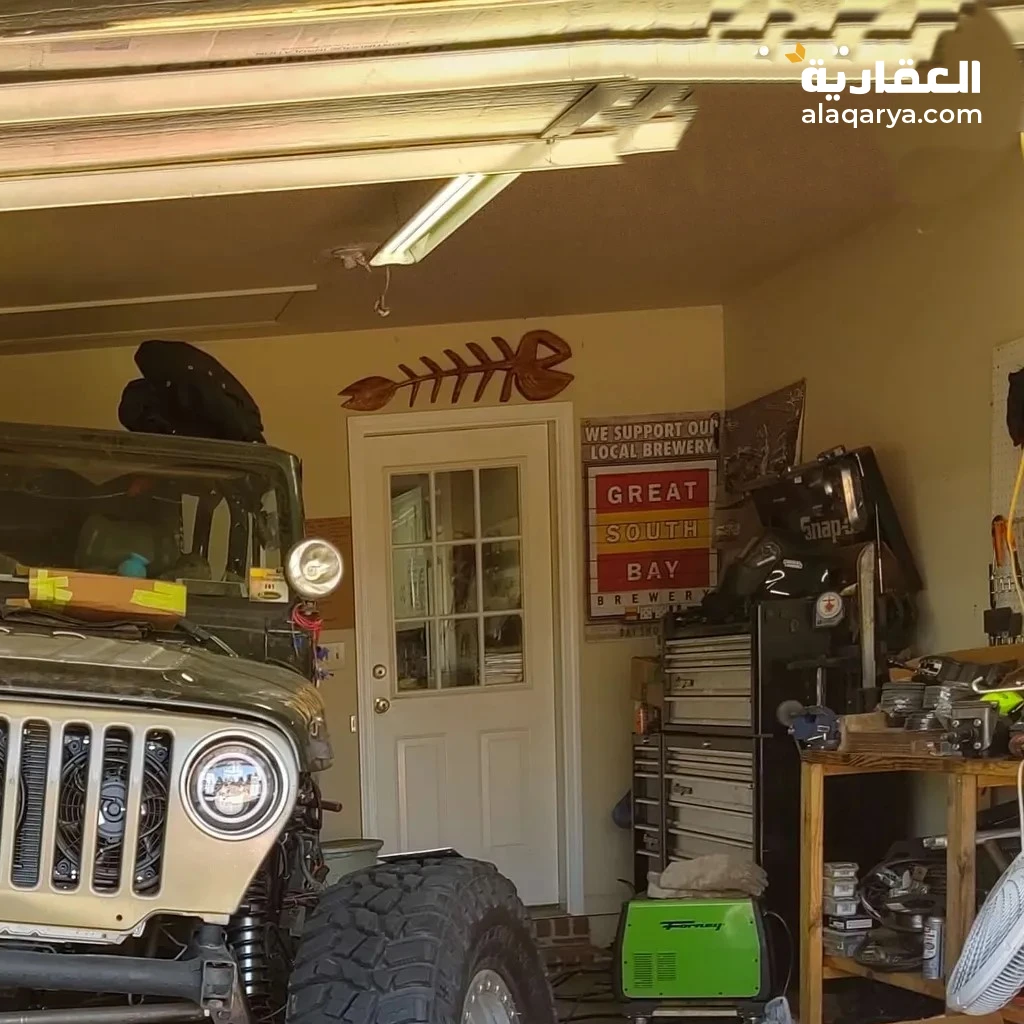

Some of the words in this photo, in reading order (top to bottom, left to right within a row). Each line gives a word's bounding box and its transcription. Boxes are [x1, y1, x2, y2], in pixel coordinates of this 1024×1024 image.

[585, 426, 608, 442] WE
[614, 421, 682, 441] SUPPORT
[590, 444, 637, 460] LOCAL
[642, 438, 715, 457] BREWERY
[607, 481, 697, 504] GREAT
[606, 521, 697, 543] SOUTH
[627, 560, 679, 581] BAY
[660, 919, 724, 931] Forney
